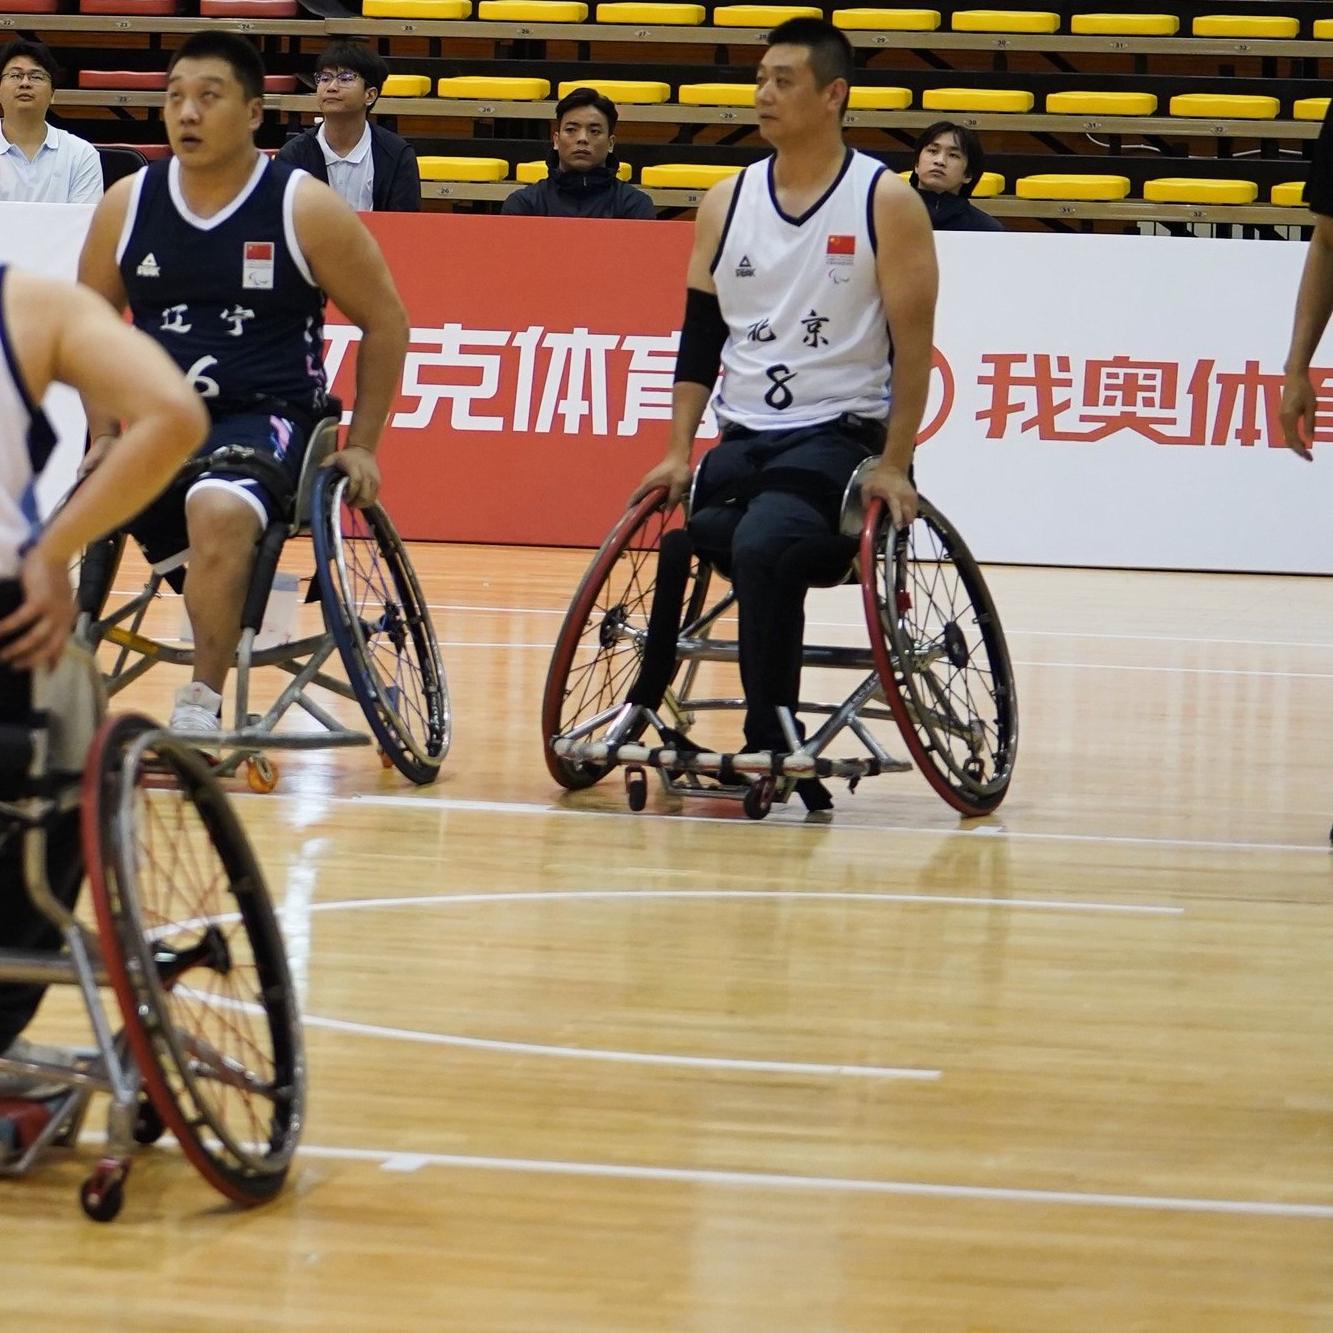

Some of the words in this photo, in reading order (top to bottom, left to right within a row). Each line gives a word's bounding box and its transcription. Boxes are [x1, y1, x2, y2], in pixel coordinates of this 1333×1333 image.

[160, 304, 255, 336] 辽宁
[748, 309, 829, 348] 北京
[185, 355, 220, 397] 6
[764, 363, 798, 410] 8
